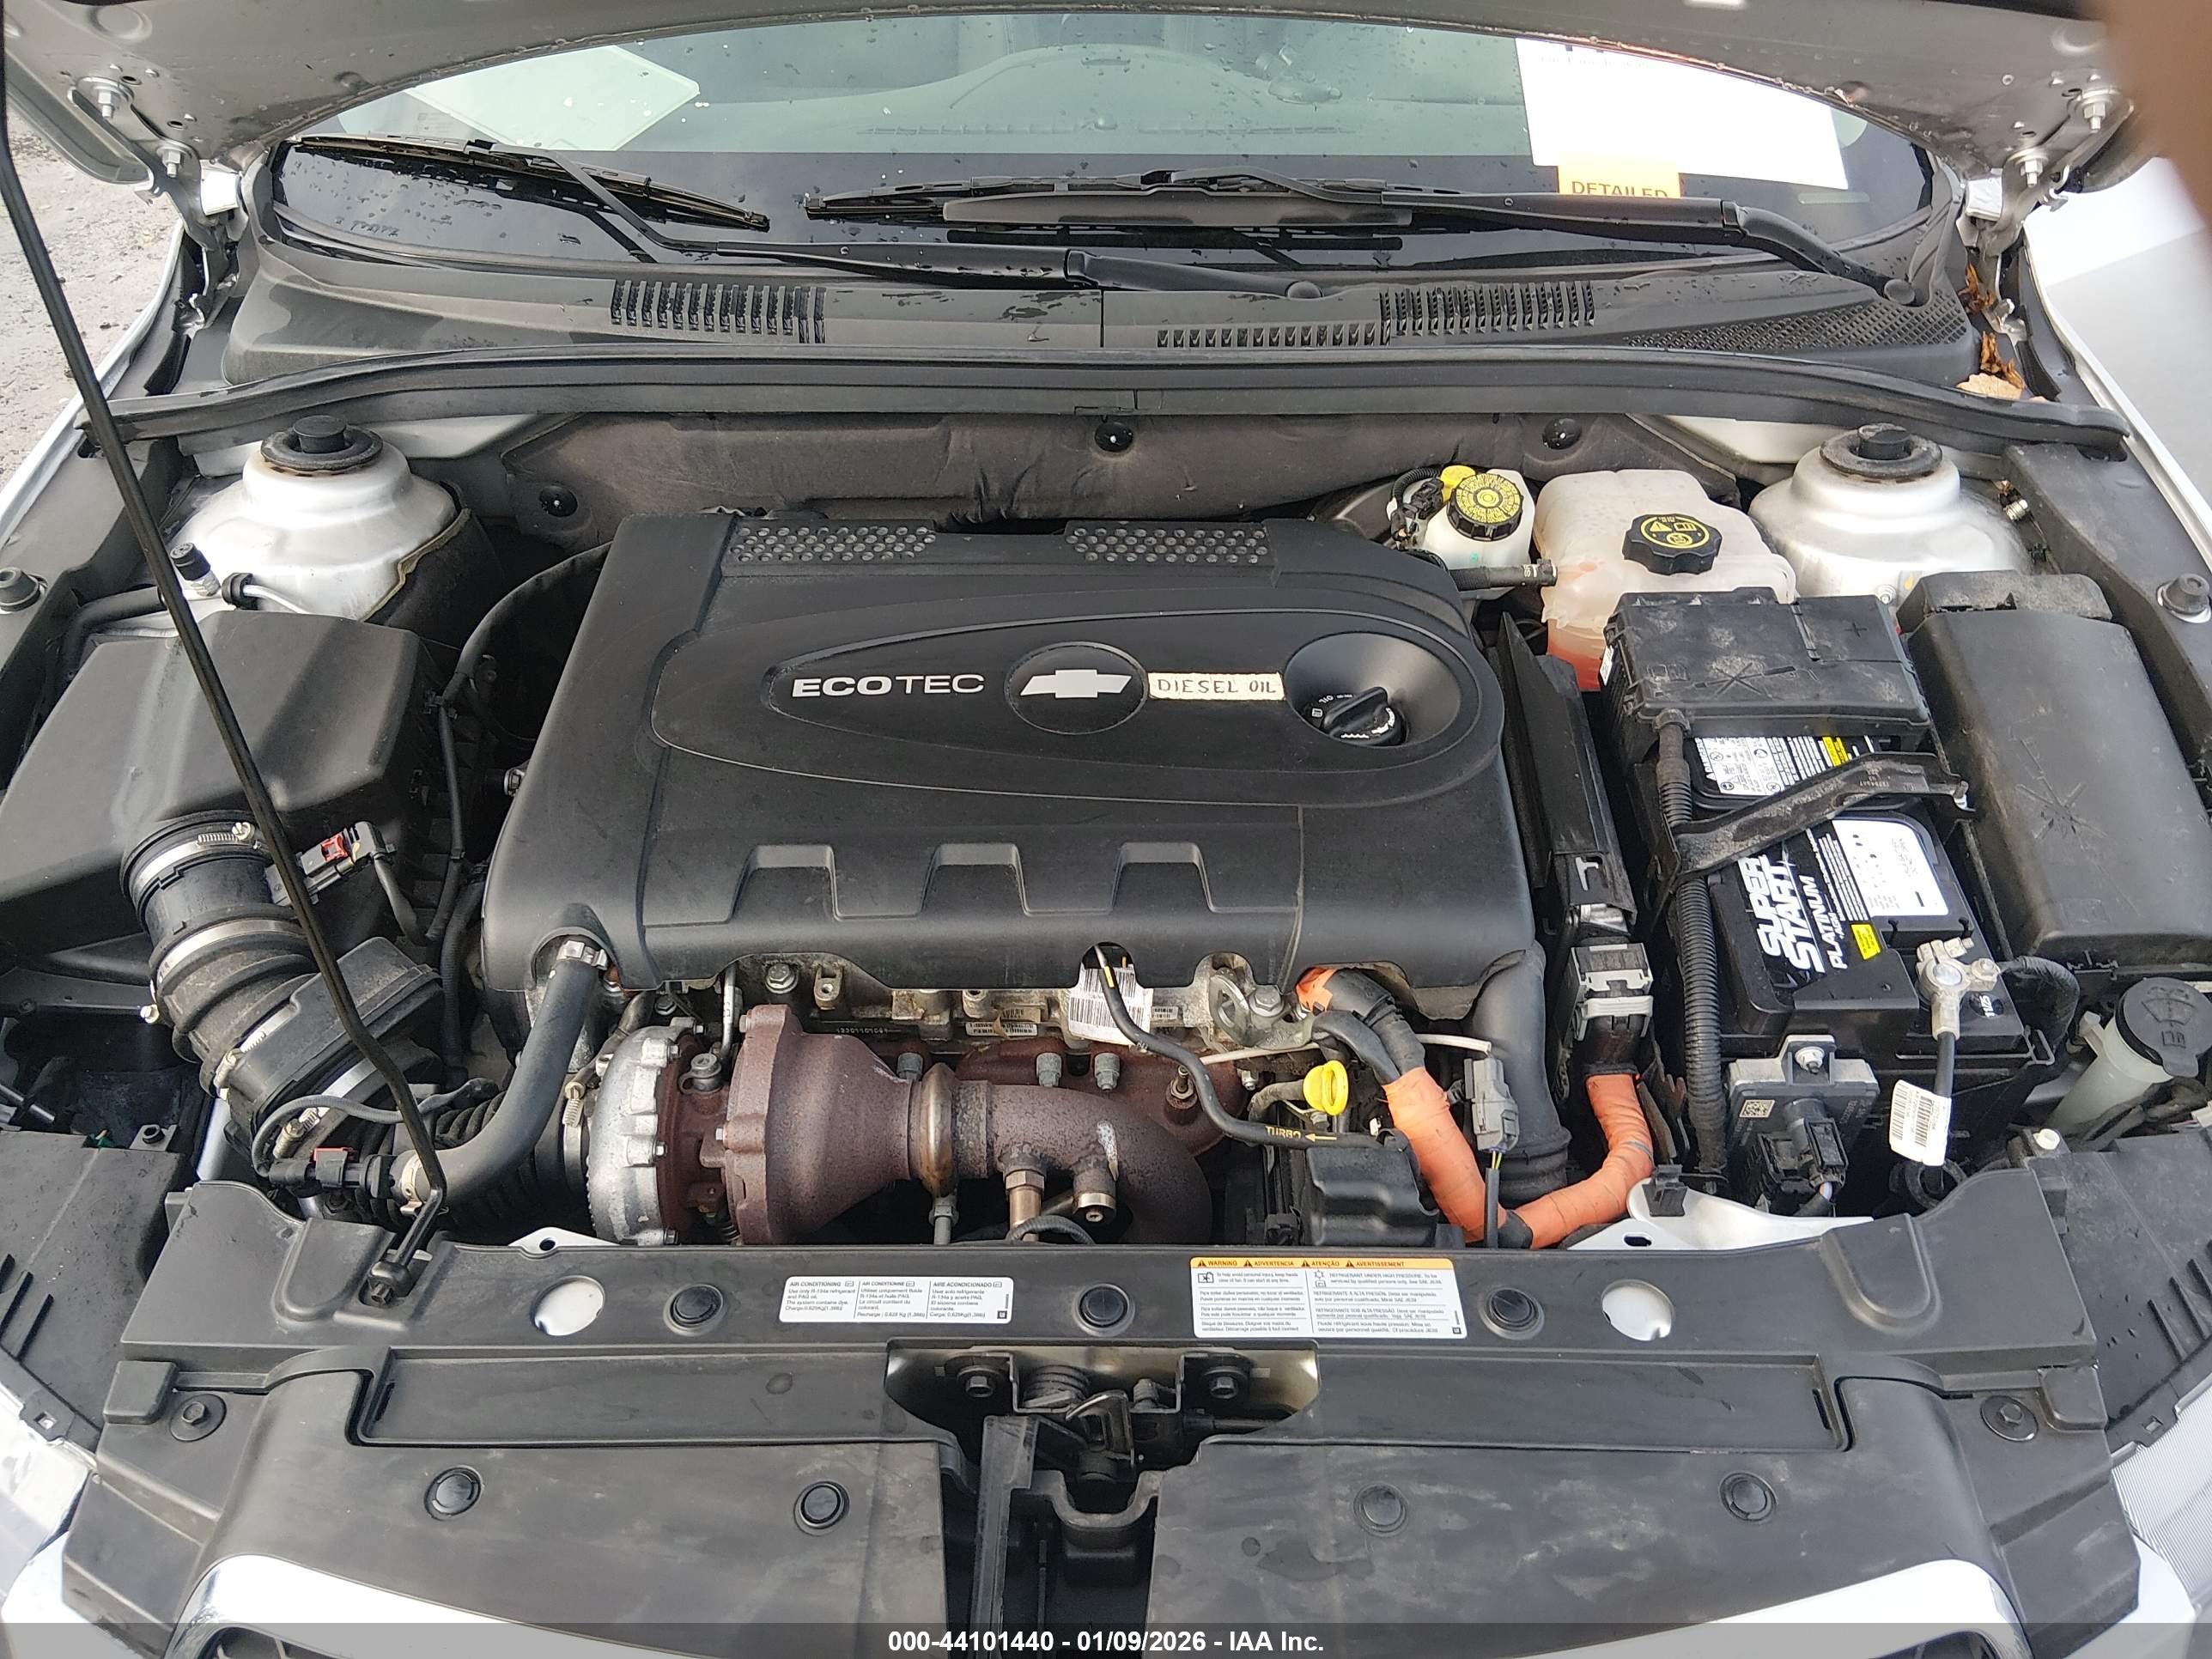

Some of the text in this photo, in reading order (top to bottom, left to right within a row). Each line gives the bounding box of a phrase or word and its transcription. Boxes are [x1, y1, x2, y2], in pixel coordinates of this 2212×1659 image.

[792, 674, 985, 697] ECOTEC
[1158, 678, 1277, 694] DIESEL OIL
[1737, 857, 1783, 956] SUPER
[1758, 854, 1826, 973] START
[1799, 875, 1848, 969] PLATINUM
[1265, 1126, 1302, 1139] TURBO
